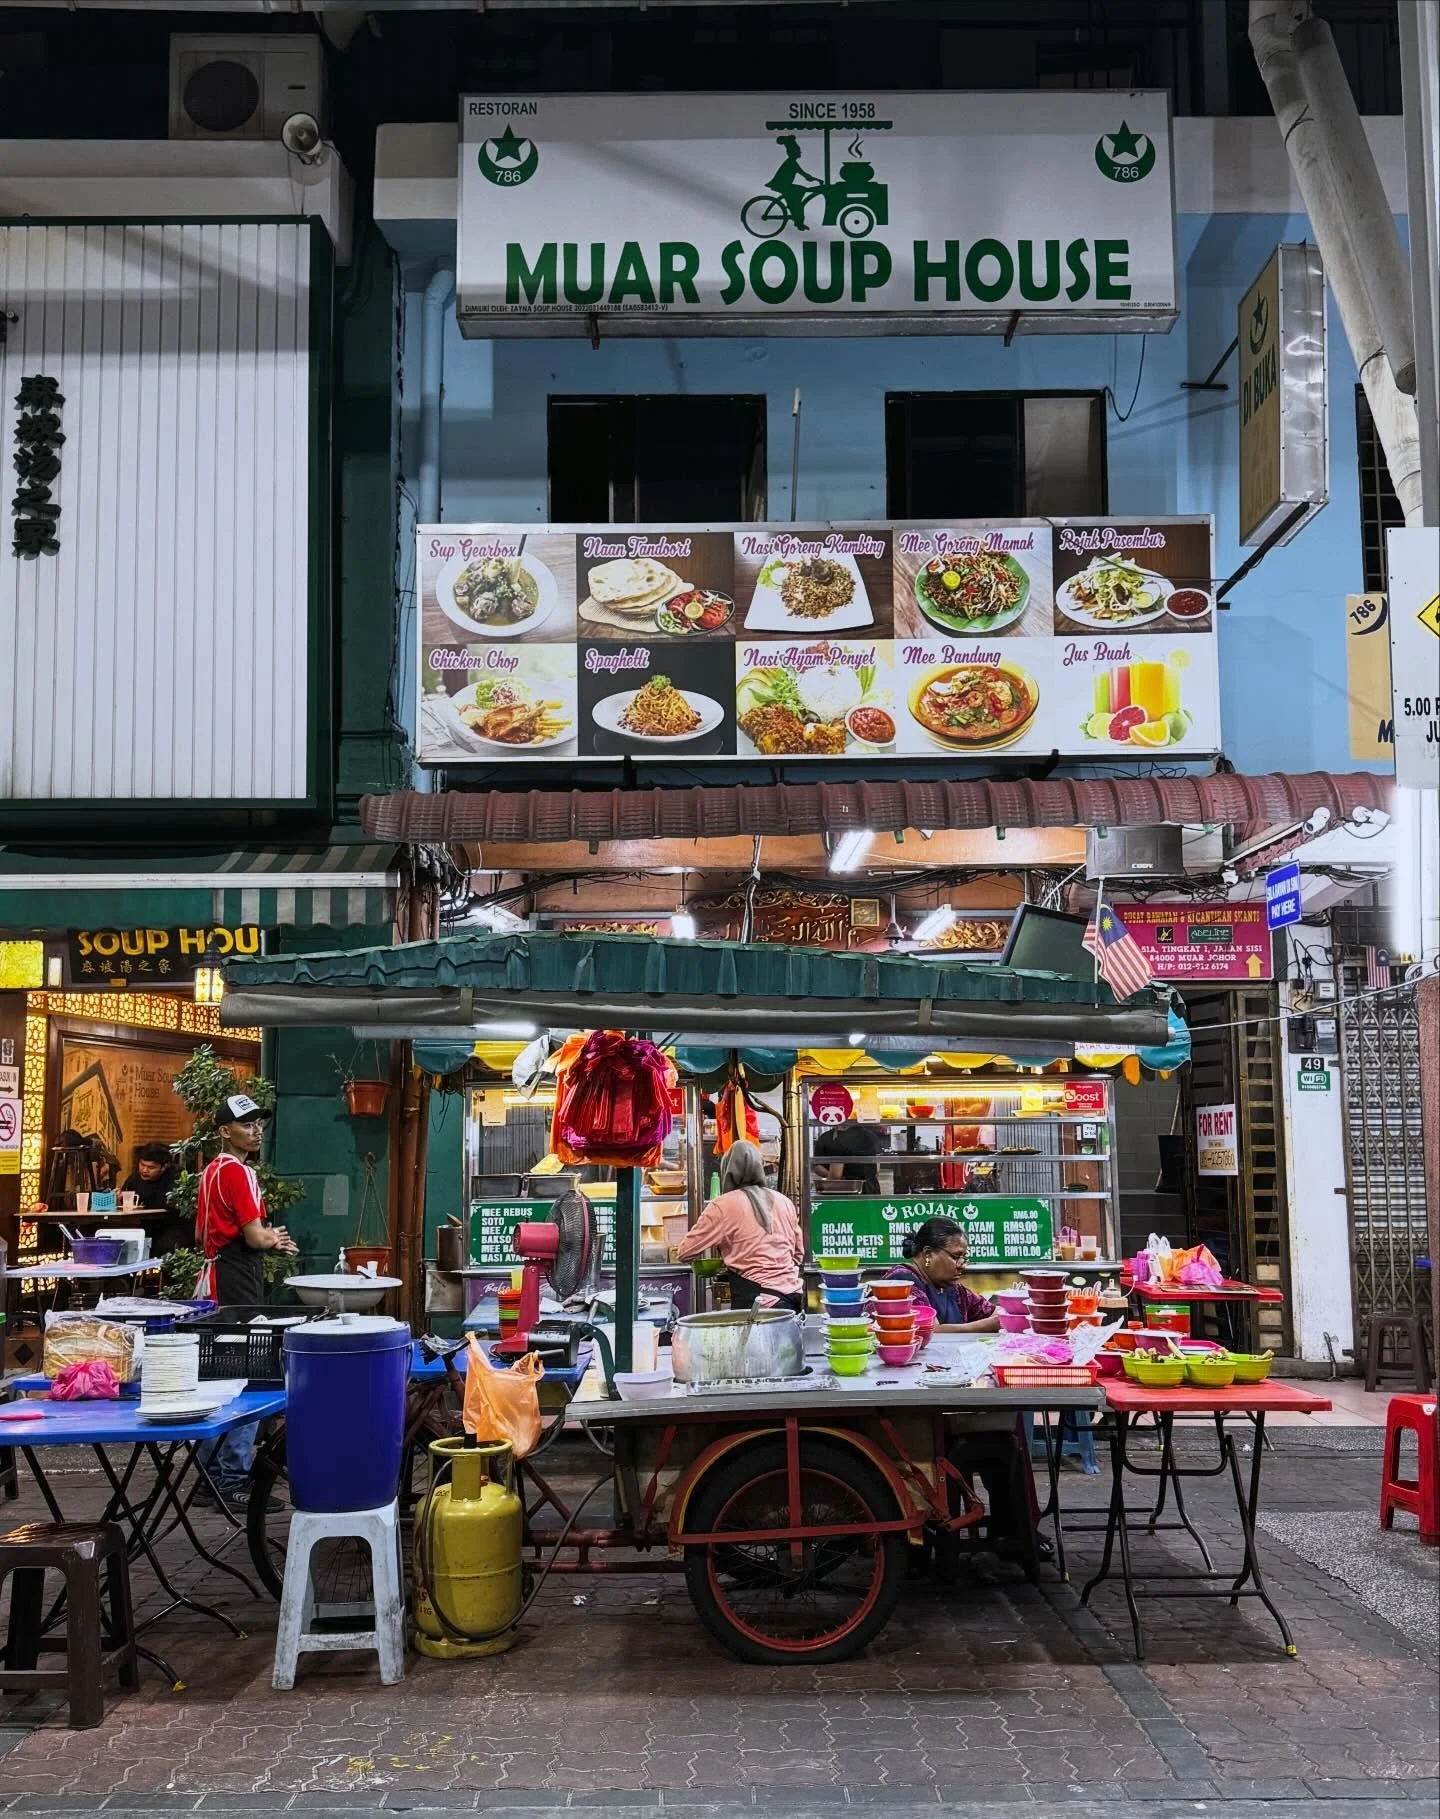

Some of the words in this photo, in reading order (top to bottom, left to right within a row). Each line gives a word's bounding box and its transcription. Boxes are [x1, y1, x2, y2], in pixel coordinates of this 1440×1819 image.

[468, 102, 538, 116] RESTORAN
[788, 103, 837, 118] SINCE
[841, 102, 876, 118] 1958
[495, 170, 522, 183] 786
[1112, 166, 1139, 179] 786
[505, 241, 701, 305] MUAR
[719, 239, 892, 305] SOUP
[913, 238, 1132, 303] HOUSE
[1243, 375, 1251, 427] DI
[1253, 343, 1277, 414] BUKA
[584, 538, 626, 557] Naan
[627, 537, 692, 556] Tandoori
[742, 536, 775, 555] Nasi
[776, 535, 821, 558] Goreng
[827, 534, 885, 557] Kambing
[900, 534, 934, 553] Mee
[937, 530, 981, 556] Goreng
[985, 530, 1035, 551] Mamak
[1060, 529, 1100, 553] Rojak
[1101, 526, 1166, 548] Pasembur
[429, 539, 455, 561] Sup
[459, 538, 517, 561] Gearbox
[1349, 599, 1377, 625] 786
[430, 649, 482, 669] Chicken
[486, 650, 519, 673] Chop
[585, 648, 650, 673] Spaghetti
[743, 647, 779, 667] Nasi
[782, 646, 824, 672] Ayam
[903, 645, 936, 665] Mee
[941, 644, 1001, 667] Bandung
[1063, 642, 1089, 666] Jus
[1096, 641, 1132, 662] Buah
[1404, 697, 1431, 716] 5.00
[78, 928, 170, 956] SOUP
[1161, 945, 1201, 954] TINGKAT
[1178, 954, 1205, 962] MUAR
[1304, 1058, 1321, 1070] 49
[1198, 1113, 1213, 1137] FOR
[1214, 1111, 1234, 1136] RENT
[503, 1208, 533, 1217] REBUS
[901, 1203, 960, 1219] ROJAK
[481, 1217, 505, 1226] SOTO
[821, 1222, 854, 1234] ROJAK
[968, 1222, 995, 1233] AYAM
[1003, 1221, 1038, 1233] RM9.00
[822, 1235, 855, 1247] ROJAK
[856, 1234, 884, 1246] PETIS
[968, 1234, 994, 1245] PARU
[1003, 1234, 1039, 1245] RM9.00
[857, 1247, 878, 1258] MEE
[1004, 1246, 1041, 1258] RM10.00
